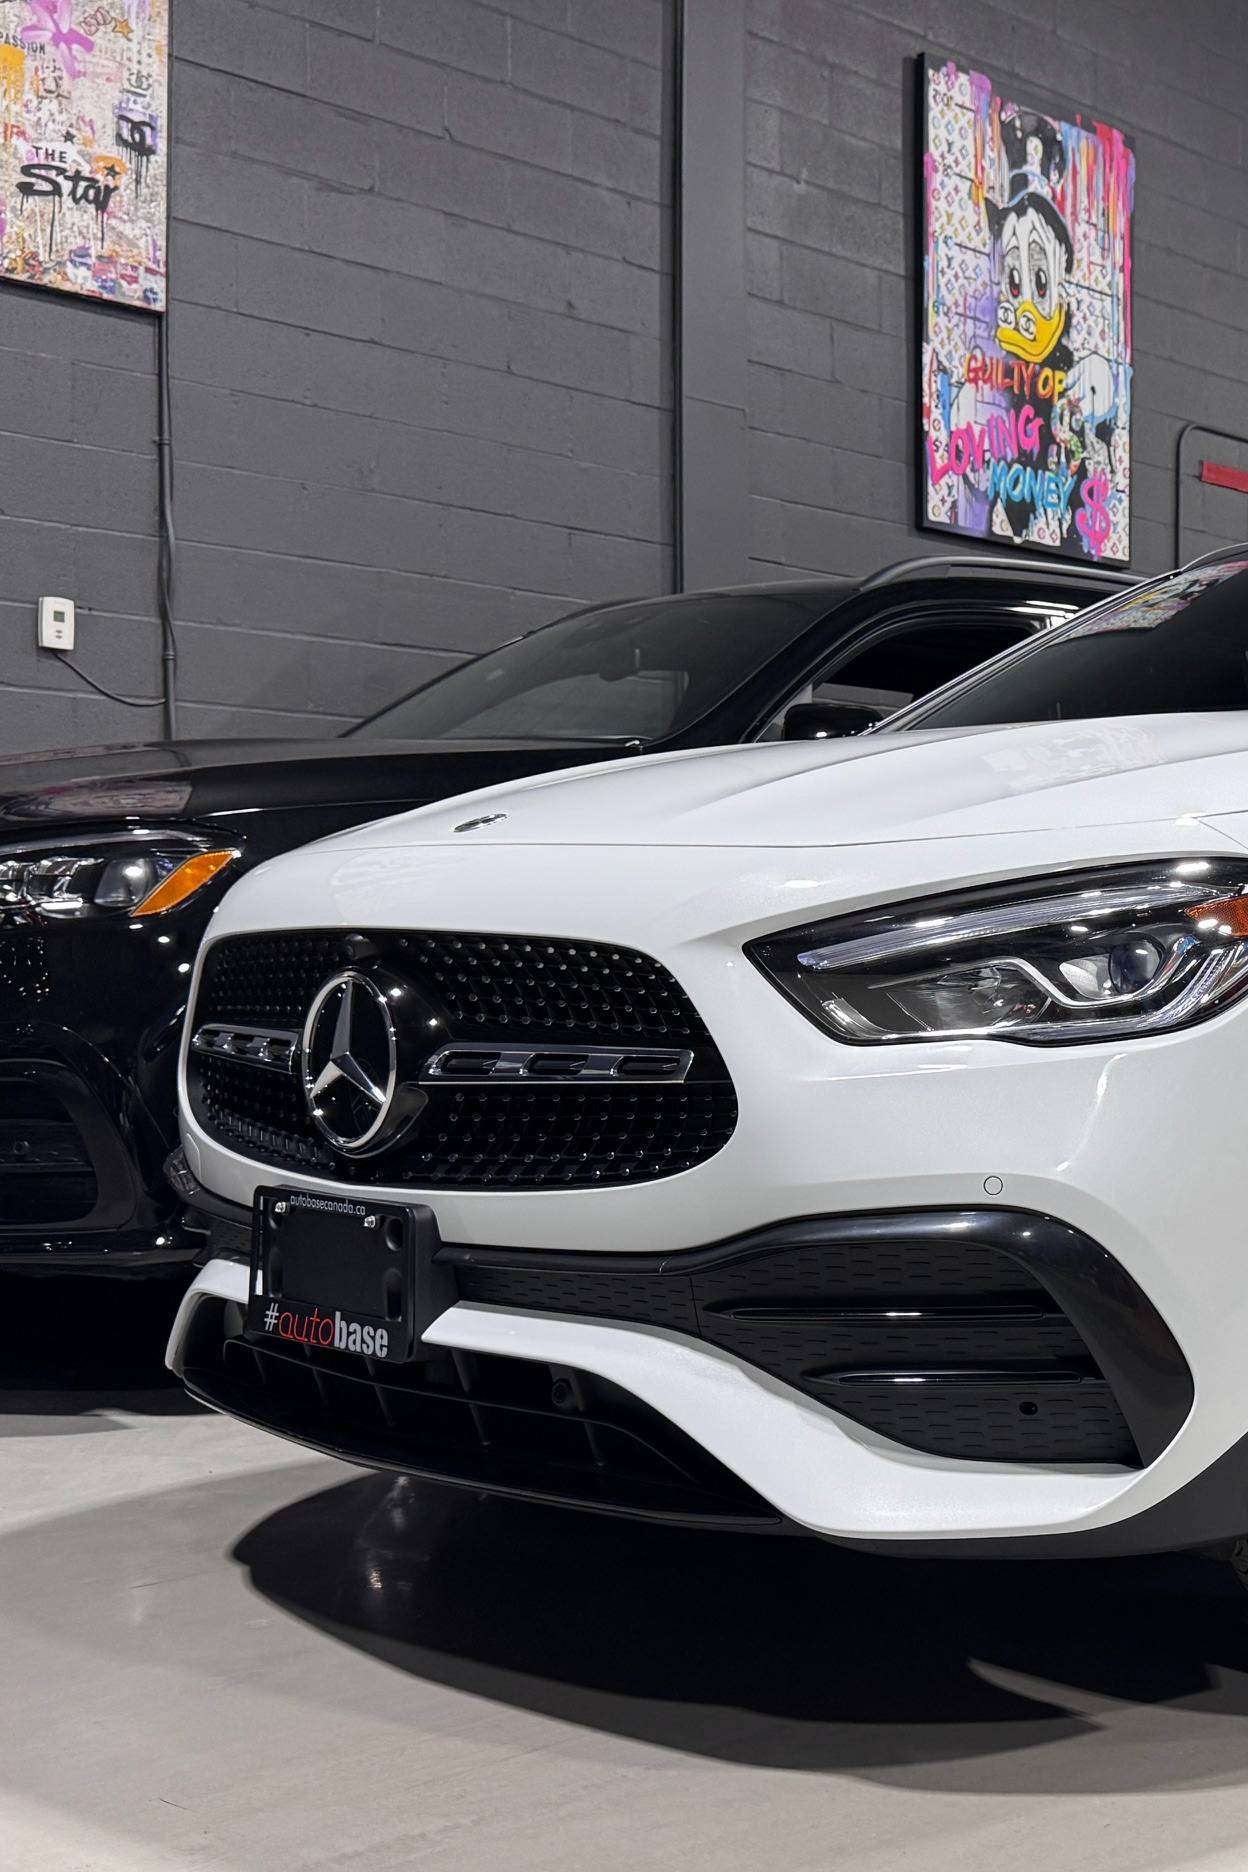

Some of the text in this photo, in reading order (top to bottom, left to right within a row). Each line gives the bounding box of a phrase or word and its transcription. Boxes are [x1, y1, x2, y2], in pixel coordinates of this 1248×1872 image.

[32, 146, 68, 164] THE
[964, 353, 1036, 400] GUILTY
[927, 404, 1045, 486] LOVING
[987, 459, 1077, 512] MONEY
[290, 1193, 366, 1216] autobasecanada.ca
[264, 1302, 389, 1358] #autobase
